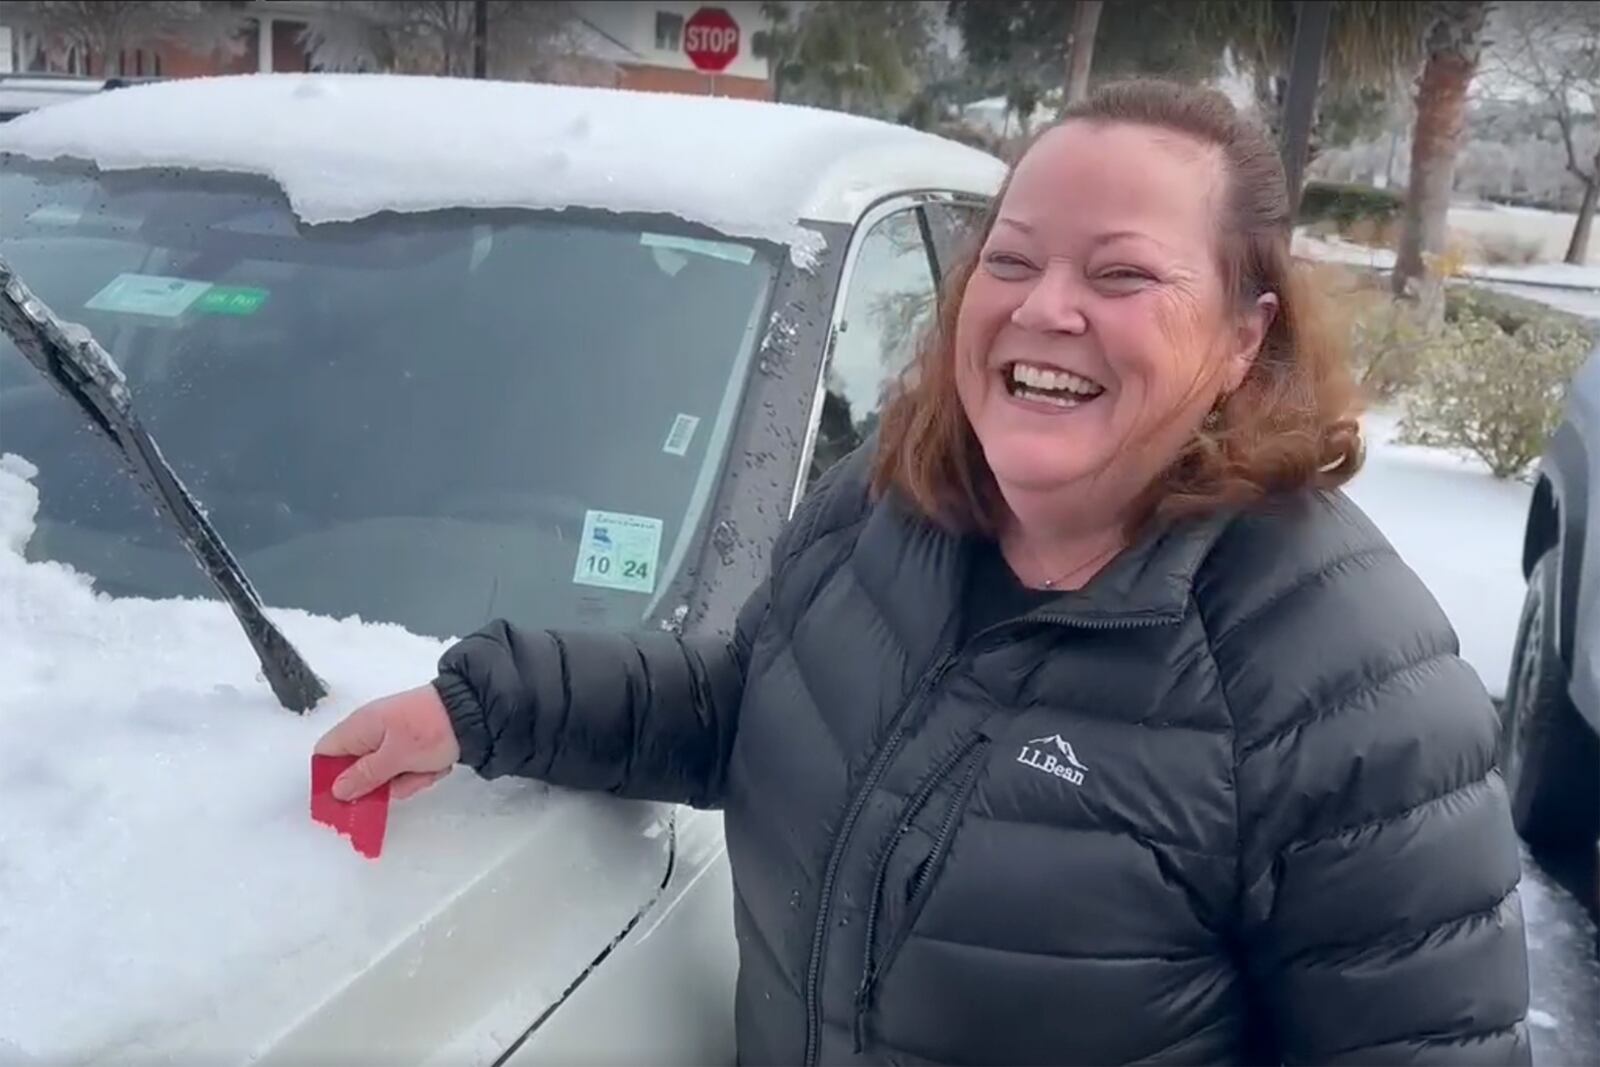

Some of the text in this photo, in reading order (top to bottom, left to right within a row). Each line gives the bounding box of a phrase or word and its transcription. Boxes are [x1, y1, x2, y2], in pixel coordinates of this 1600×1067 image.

[687, 26, 737, 53] STOP
[586, 555, 648, 579] 10 24
